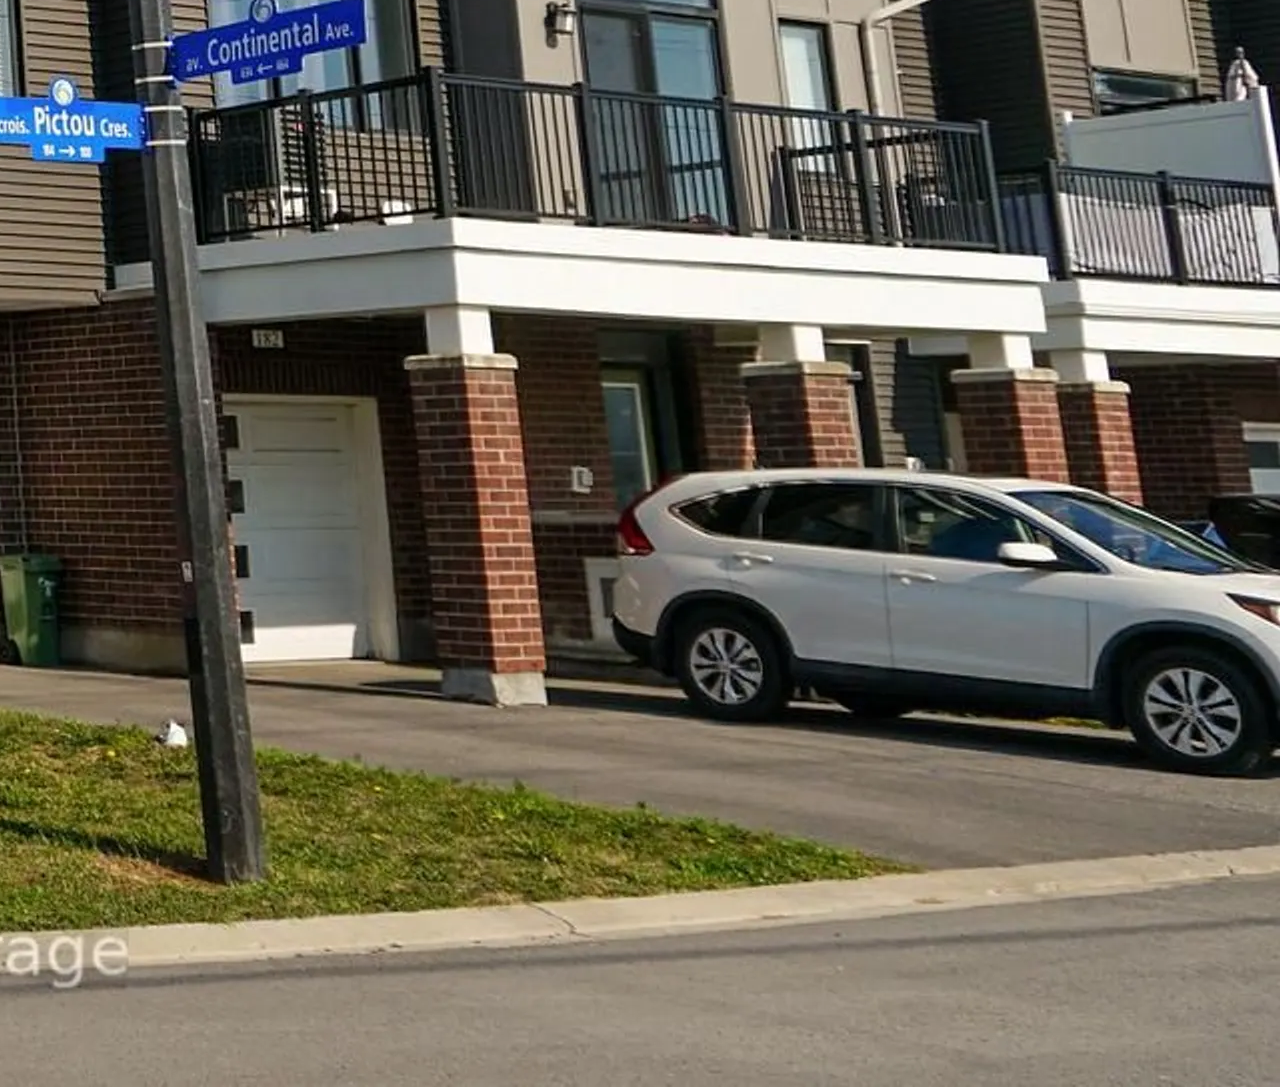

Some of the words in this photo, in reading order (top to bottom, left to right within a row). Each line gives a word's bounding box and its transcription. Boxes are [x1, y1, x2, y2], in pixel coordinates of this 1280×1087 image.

[186, 56, 204, 72] av.
[207, 12, 320, 66] Continental
[324, 21, 354, 42] Ave.
[33, 105, 95, 136] Pictou
[100, 118, 132, 138] Cres.
